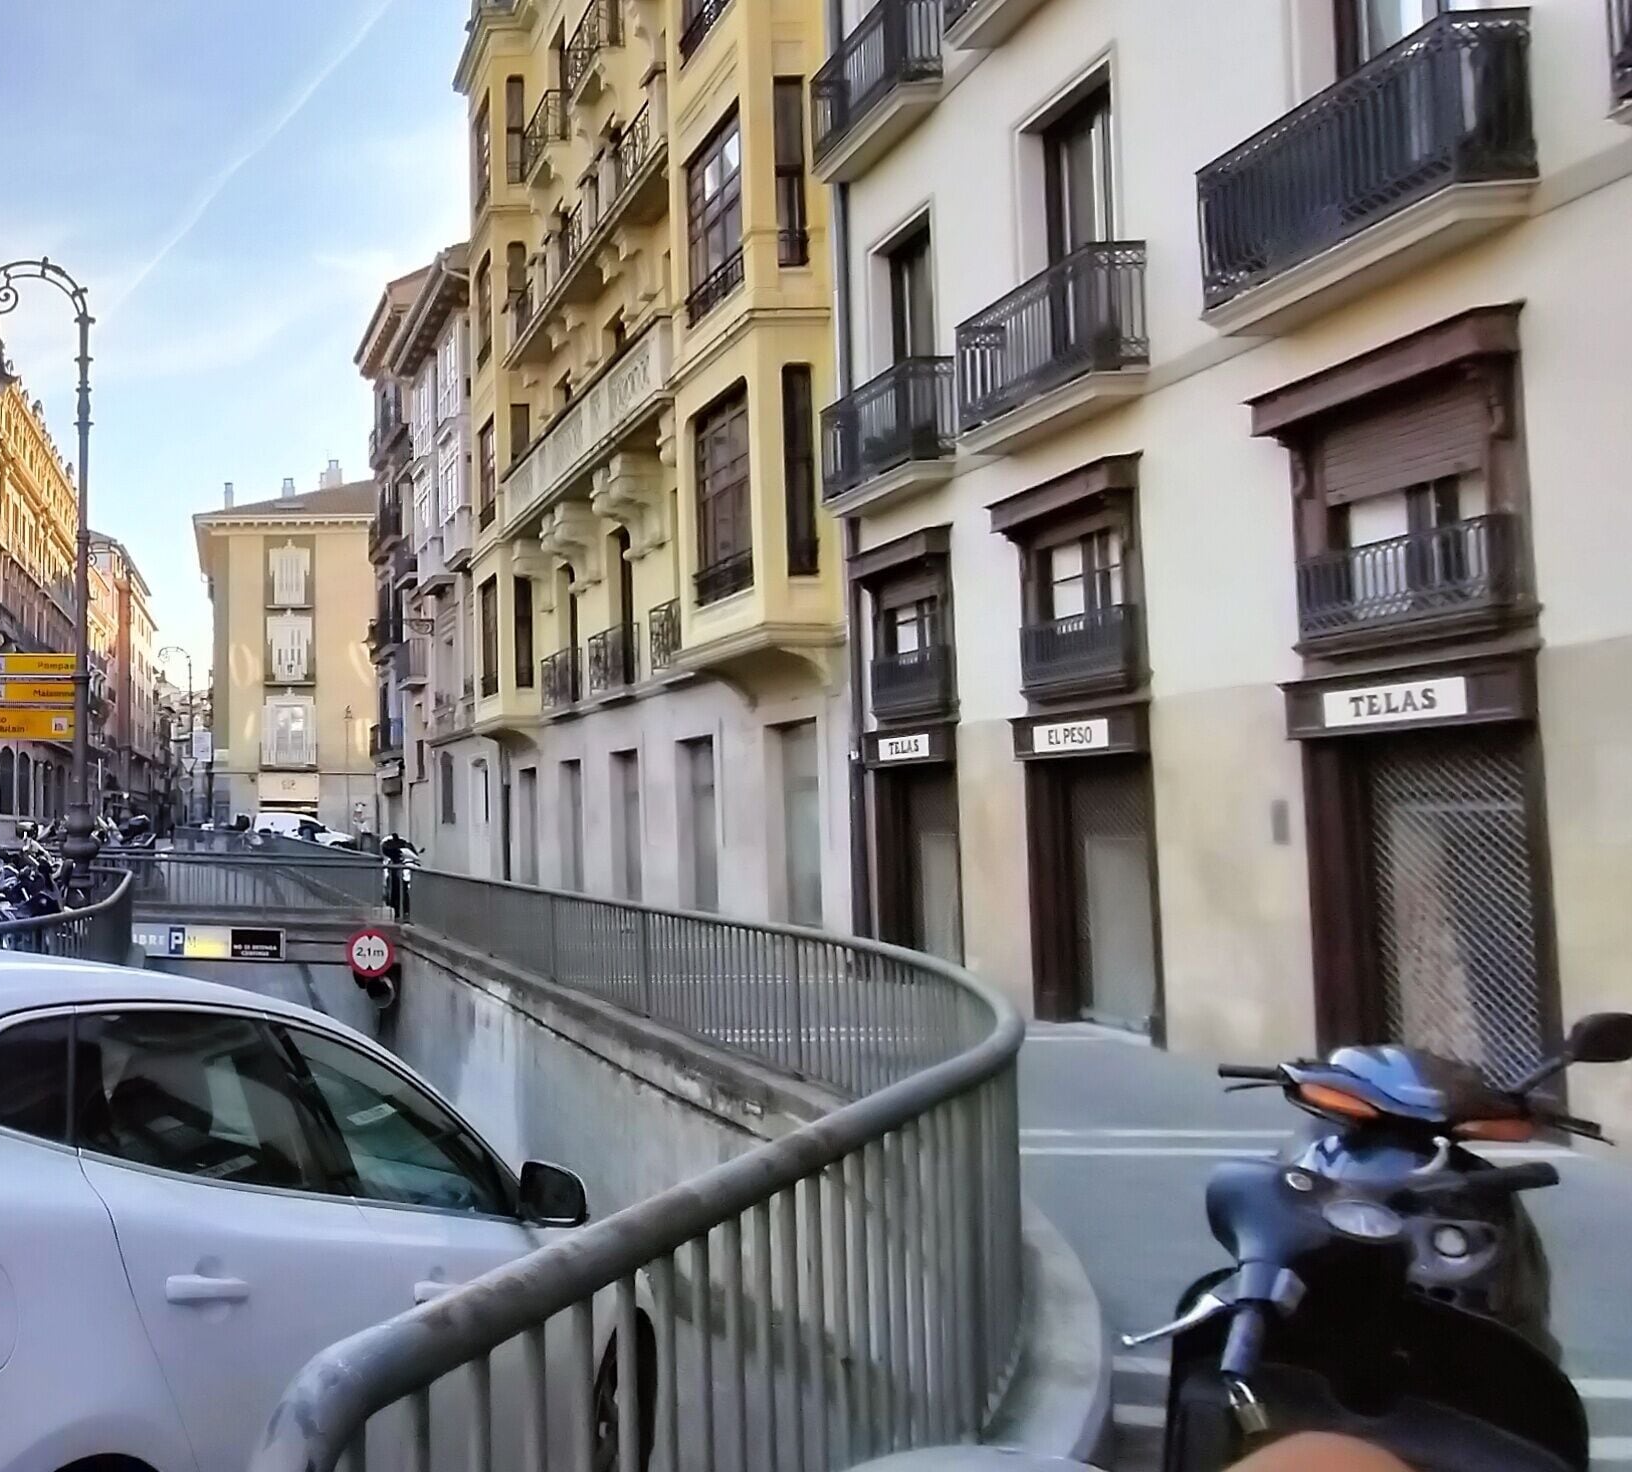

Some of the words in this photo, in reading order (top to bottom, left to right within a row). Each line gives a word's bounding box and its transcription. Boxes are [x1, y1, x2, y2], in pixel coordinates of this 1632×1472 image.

[1349, 688, 1437, 717] TELAS
[1048, 729, 1061, 745] EL
[1063, 726, 1092, 744] PESO
[889, 739, 919, 755] TELAS
